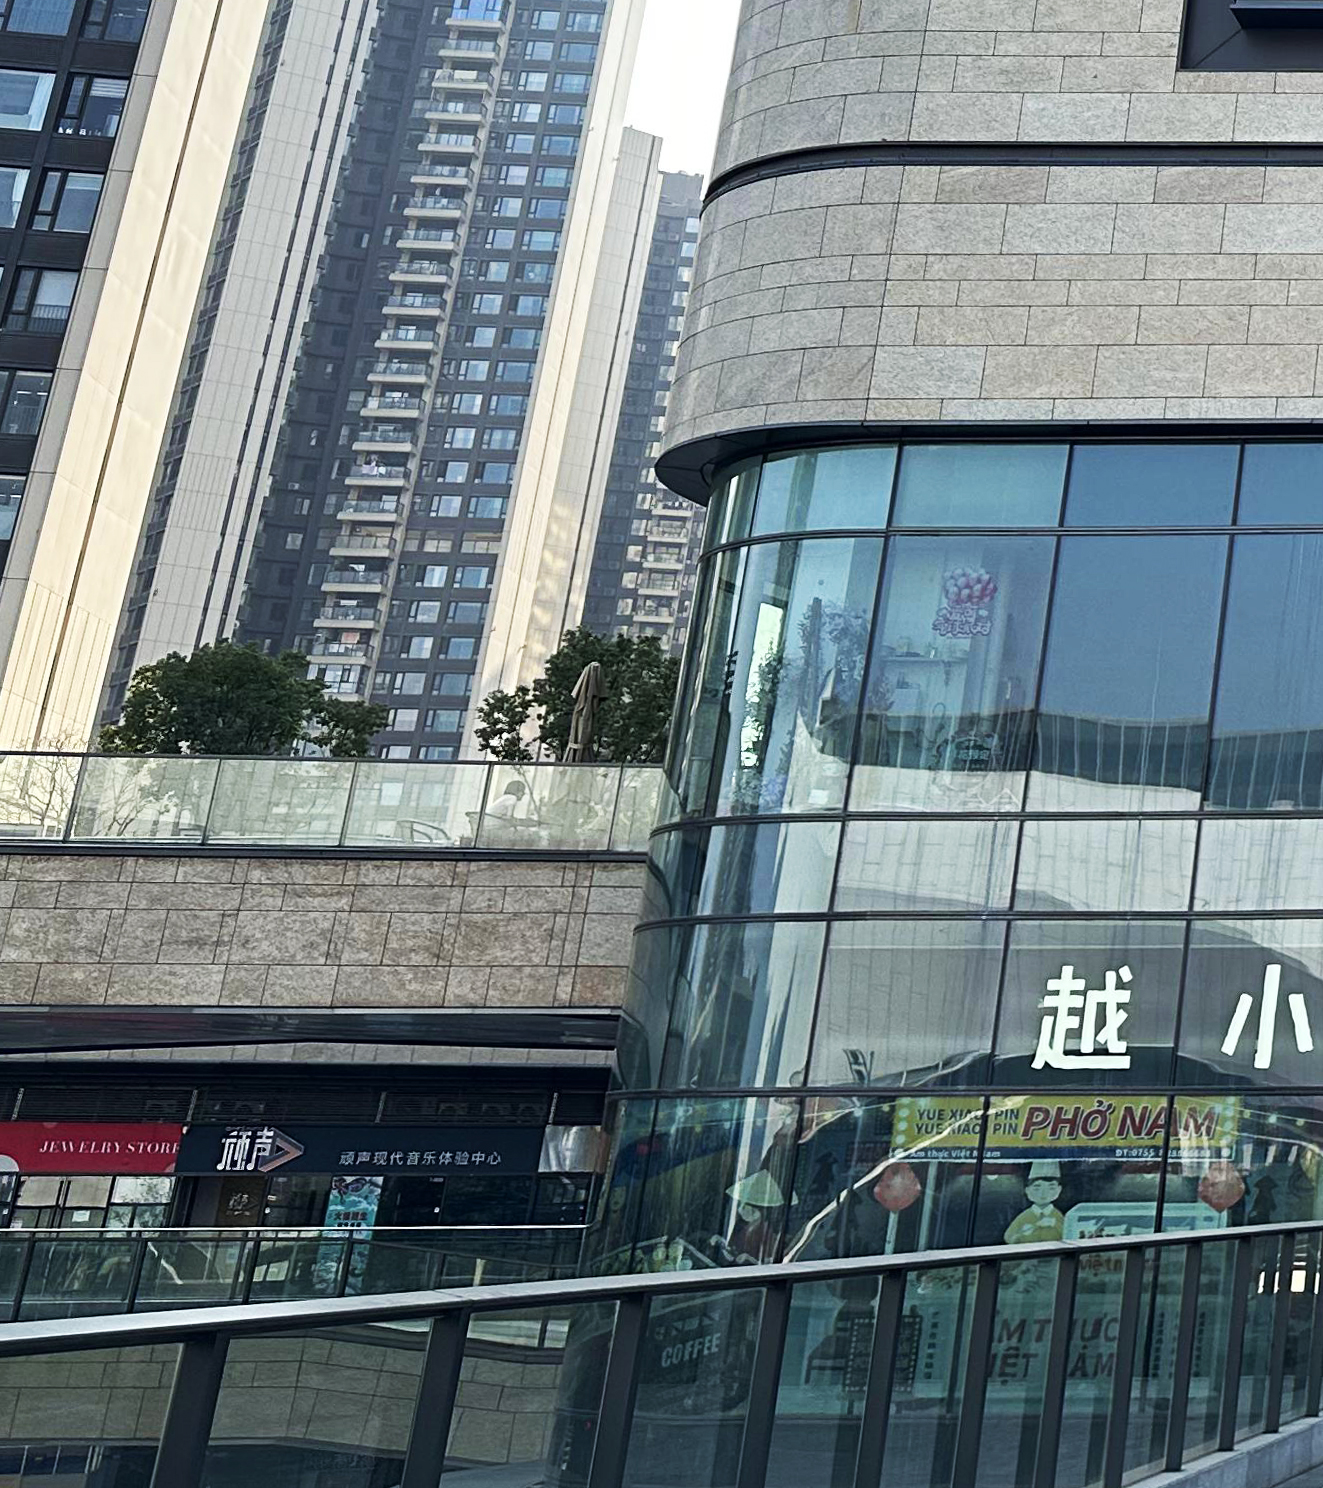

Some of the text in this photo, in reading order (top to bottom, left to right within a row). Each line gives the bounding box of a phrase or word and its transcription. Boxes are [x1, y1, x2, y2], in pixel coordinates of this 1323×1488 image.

[917, 1108, 945, 1121] YUE
[994, 1108, 1019, 1121] PIN
[915, 1122, 944, 1135] YUE
[992, 1122, 1018, 1135] PIN
[1116, 1105, 1219, 1141] NAM
[39, 1140, 121, 1155] JEWELRY
[339, 1150, 502, 1166] 顽声现代音乐体验中心
[661, 1333, 721, 1369] COFFEE
